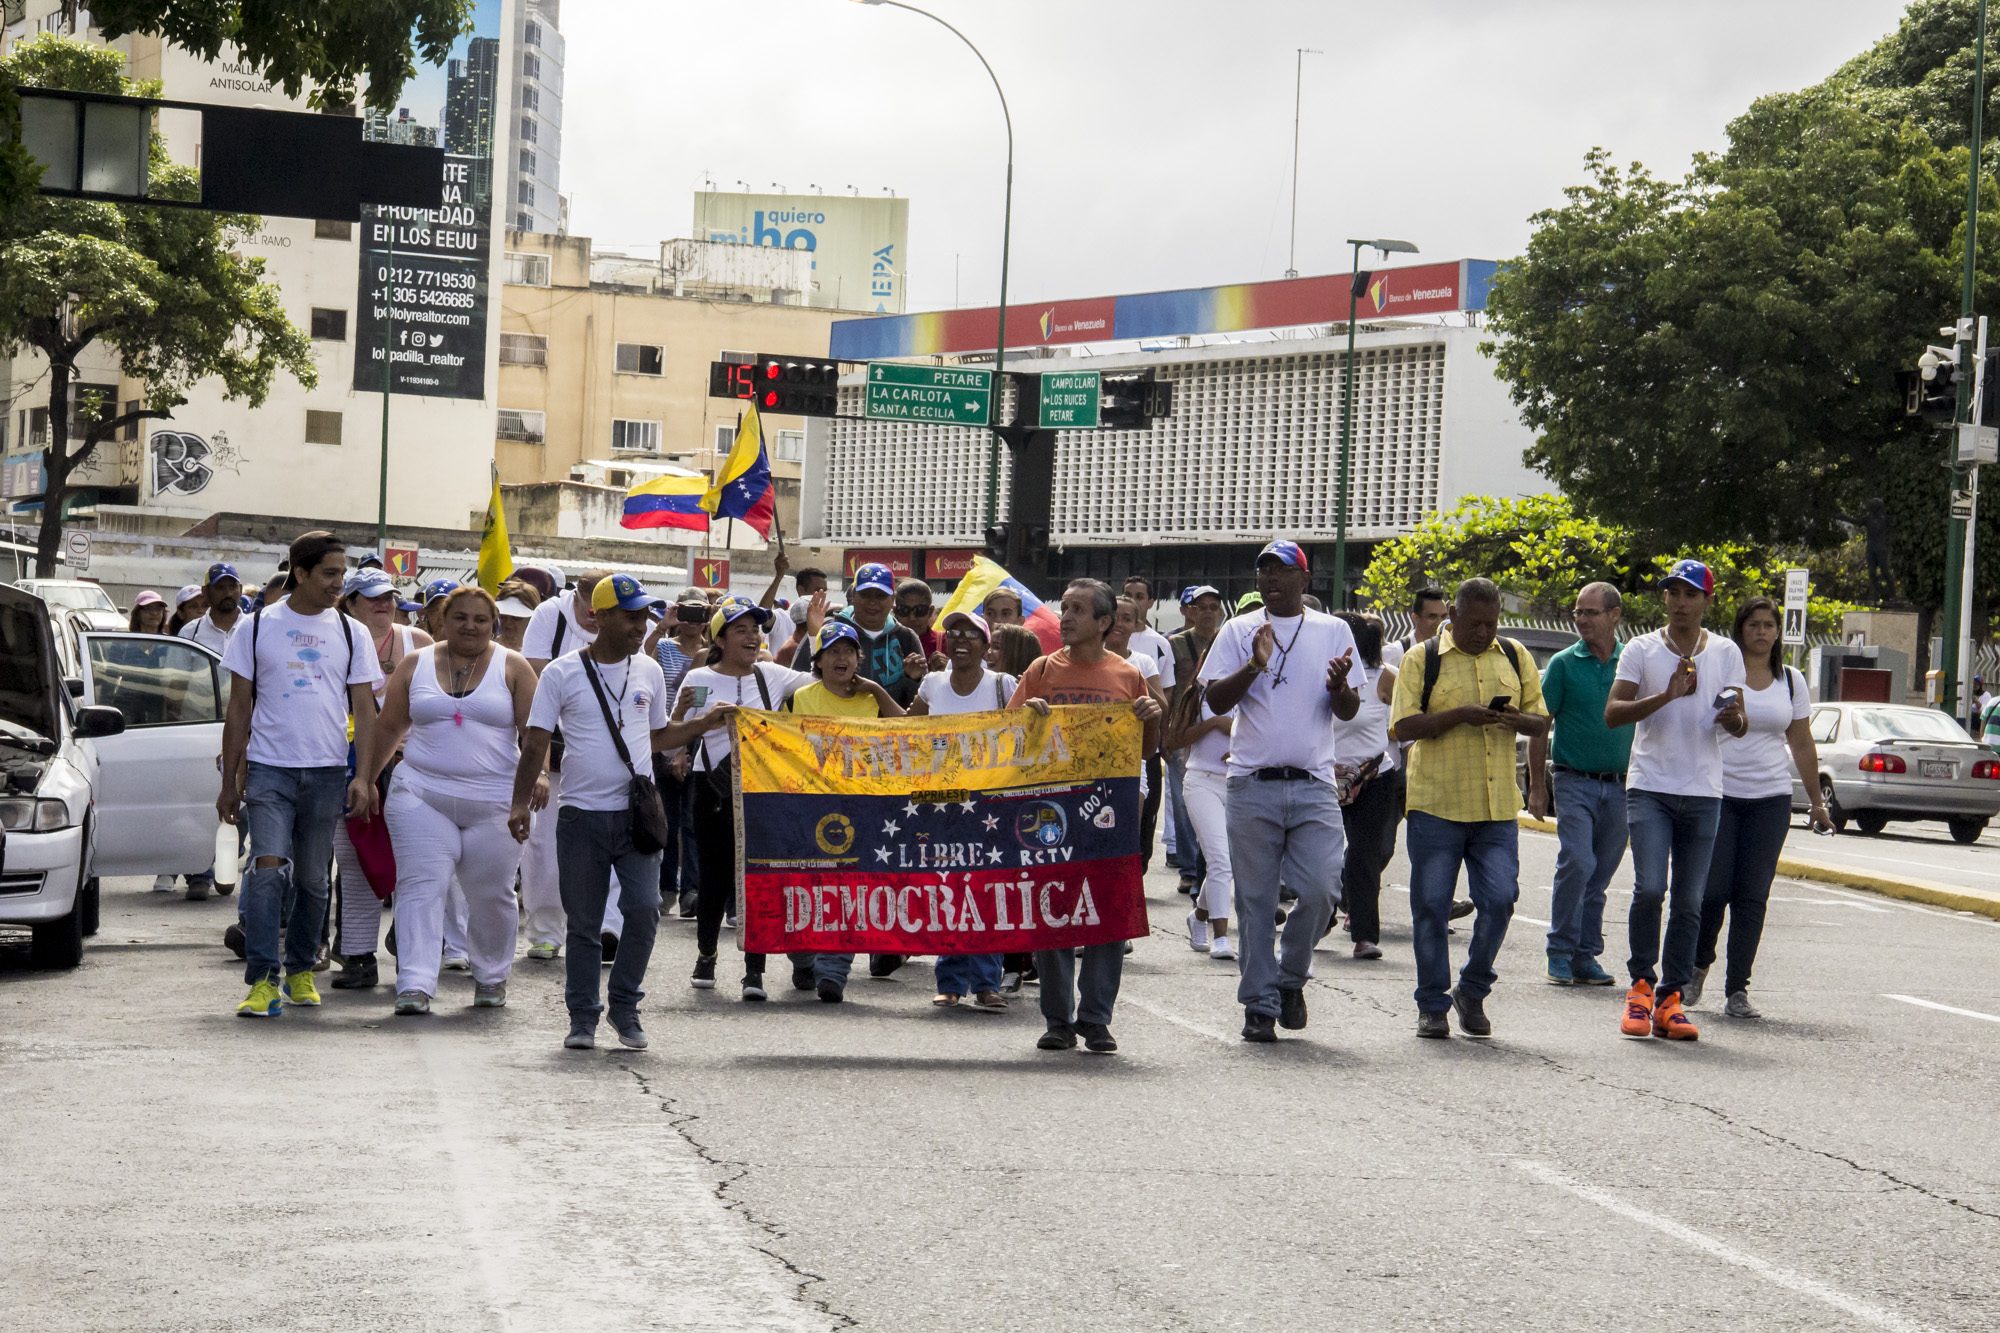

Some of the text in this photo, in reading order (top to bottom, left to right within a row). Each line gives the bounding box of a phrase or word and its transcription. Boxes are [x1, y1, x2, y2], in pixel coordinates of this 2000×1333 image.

[222, 63, 260, 76] MALLA
[209, 78, 272, 93] ANTISOLAR
[377, 204, 475, 226] PROPIEDAD
[768, 207, 826, 226] quiero
[262, 235, 292, 248] RAMO
[373, 224, 478, 250] EN LOS EEUU
[378, 266, 476, 290] 0212 7719530
[872, 244, 894, 297] EPA
[392, 287, 417, 303] 305
[420, 290, 475, 308] 5426685
[1389, 294, 1404, 303] Banco
[1412, 286, 1452, 300] Venezuela
[1074, 319, 1105, 330] Venezuela
[727, 364, 753, 398] 15
[934, 372, 983, 386] PETARE
[1051, 377, 1096, 389] CAMPO CLARO
[872, 388, 952, 403] LA CARLOTA
[1050, 394, 1087, 406] LOS RUICES
[872, 402, 955, 419] SANTA CECILIA
[1049, 410, 1074, 422] PETARE
[943, 558, 975, 570] ServiciosC
[805, 722, 1071, 777] VENEZUELA
[910, 789, 960, 801] CAPRILES
[898, 842, 984, 868] LIBRE
[1020, 846, 1073, 866] RCTV
[936, 871, 950, 883] Y
[783, 872, 1100, 933] DEMOCRÁTICA
